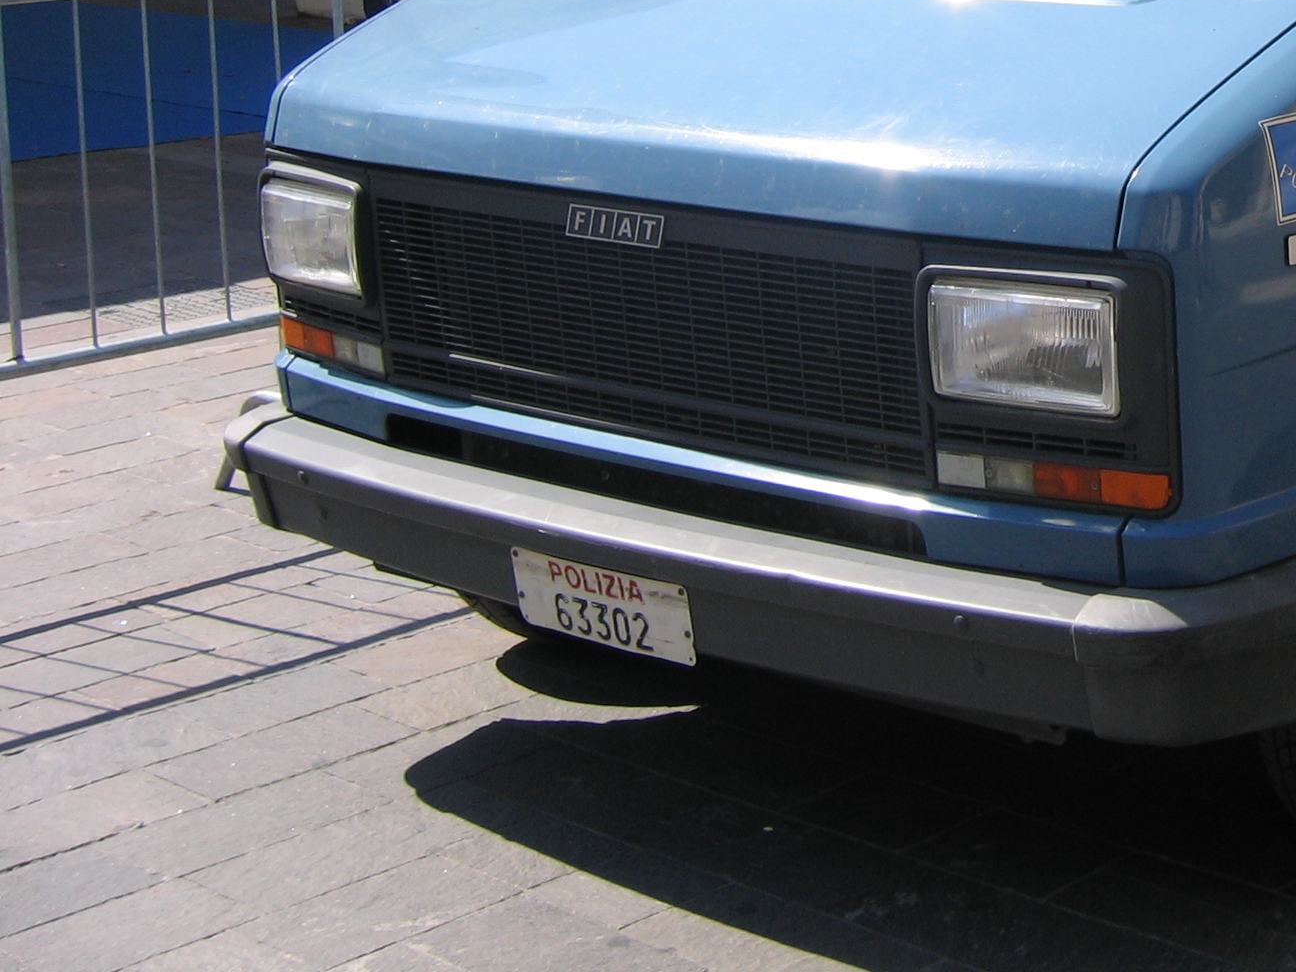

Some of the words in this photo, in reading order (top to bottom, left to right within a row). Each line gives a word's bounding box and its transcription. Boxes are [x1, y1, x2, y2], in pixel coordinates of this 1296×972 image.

[573, 210, 657, 241] FIAT
[547, 560, 645, 605] POLIZIA
[555, 593, 654, 652] 63302
